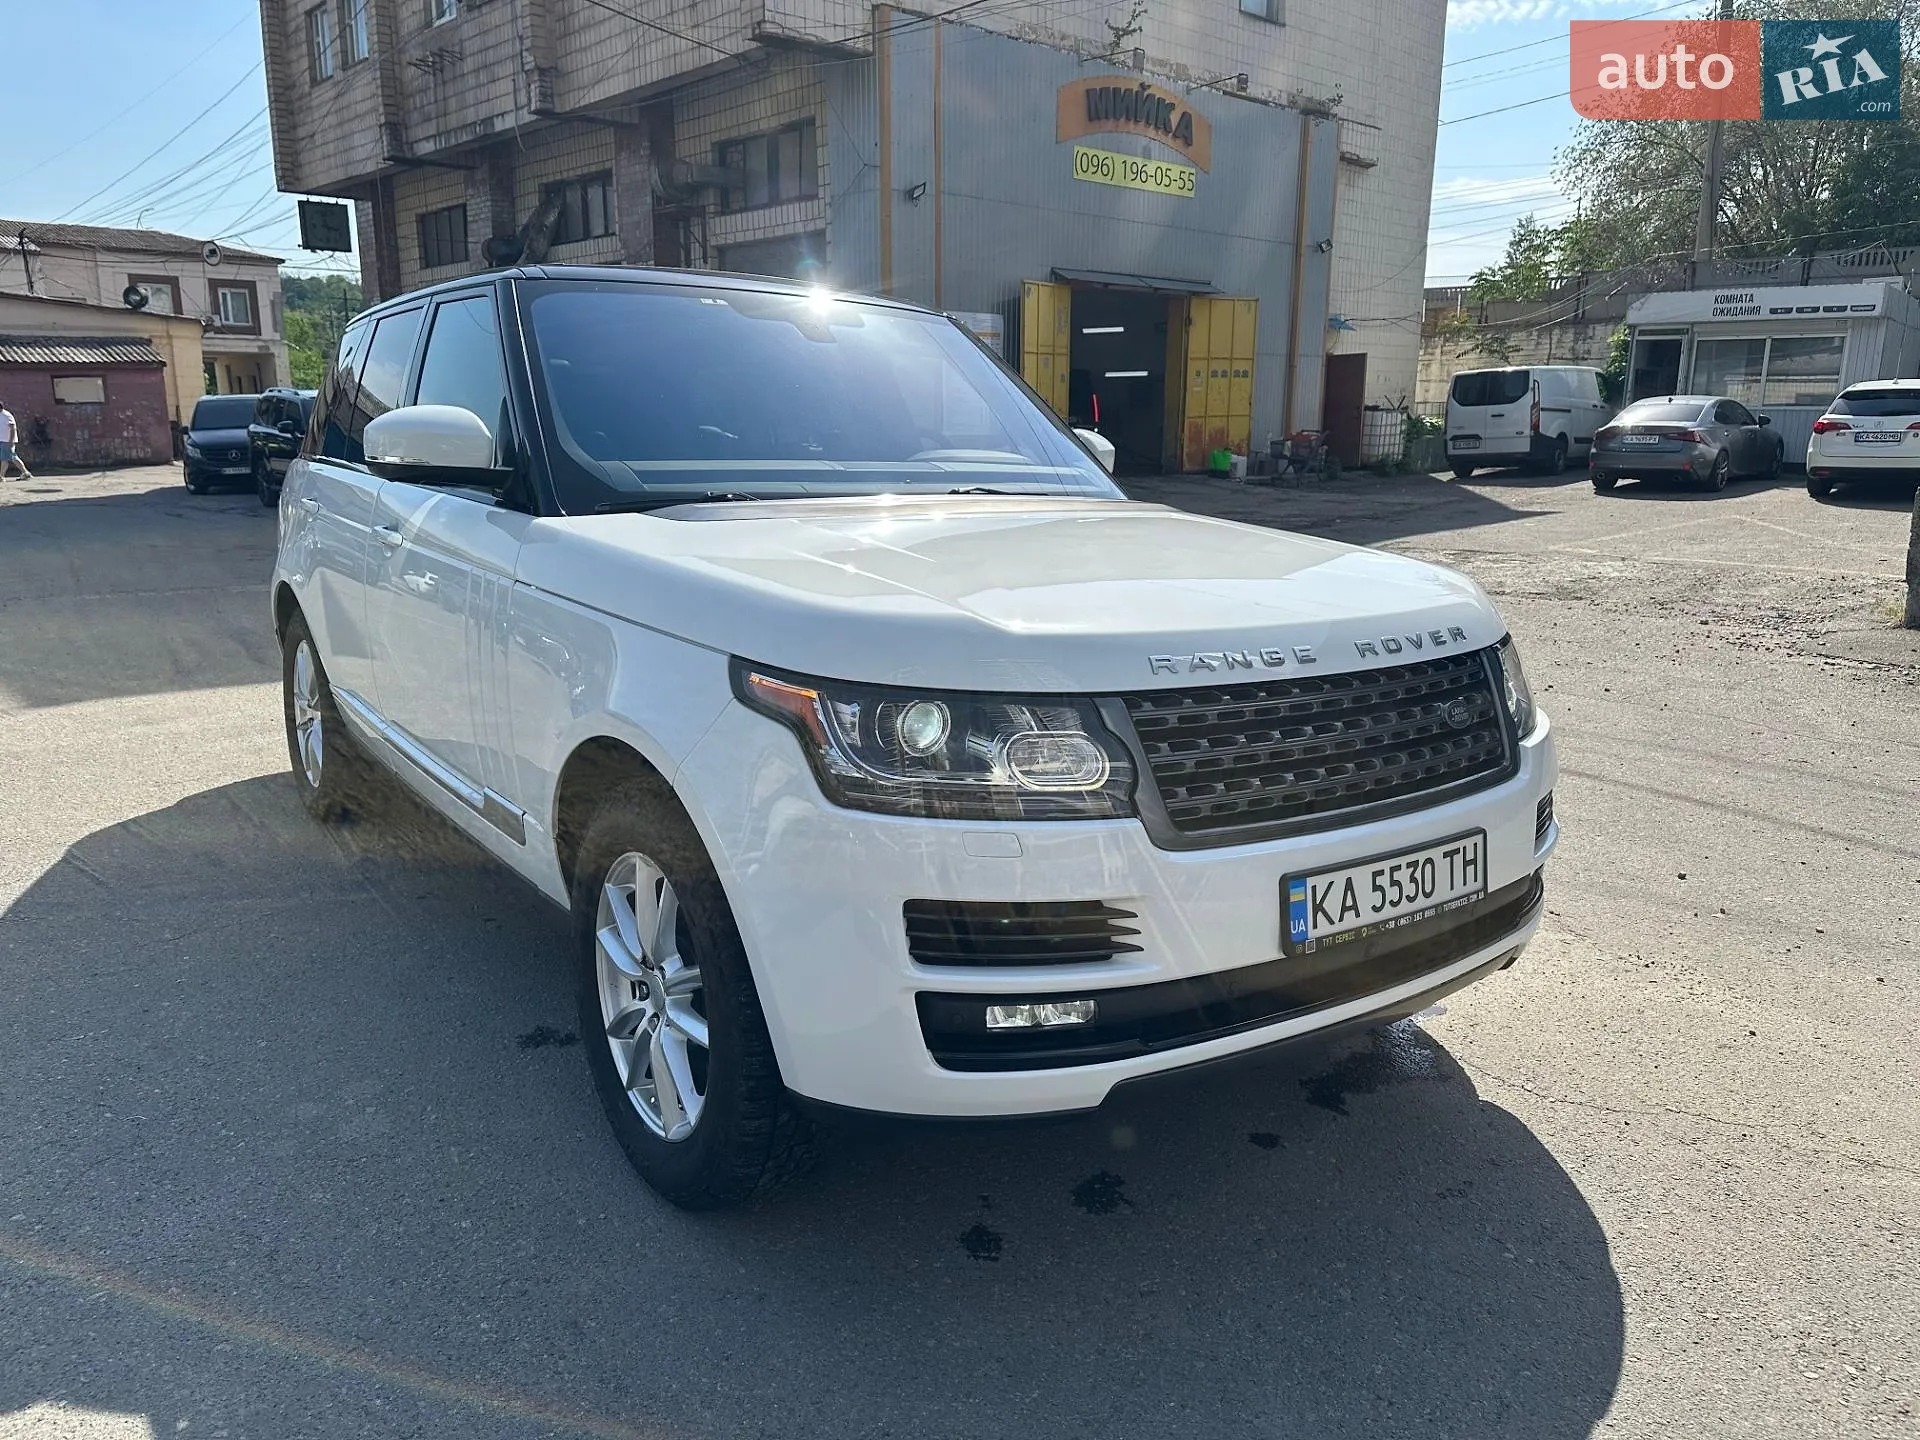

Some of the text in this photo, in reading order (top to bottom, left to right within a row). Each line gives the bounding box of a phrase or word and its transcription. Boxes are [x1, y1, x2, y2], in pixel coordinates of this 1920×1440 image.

[1086, 81, 1194, 147] МИЙКА
[1074, 149, 1195, 192] (096) 196-05-55
[1712, 305, 1761, 317] ОЖИДАНИЯ
[1714, 293, 1754, 305] КОМНАТА
[1148, 625, 1467, 676] RANGE ROVER
[1311, 842, 1478, 930] KA 5530 TH
[1290, 919, 1306, 934] UA
